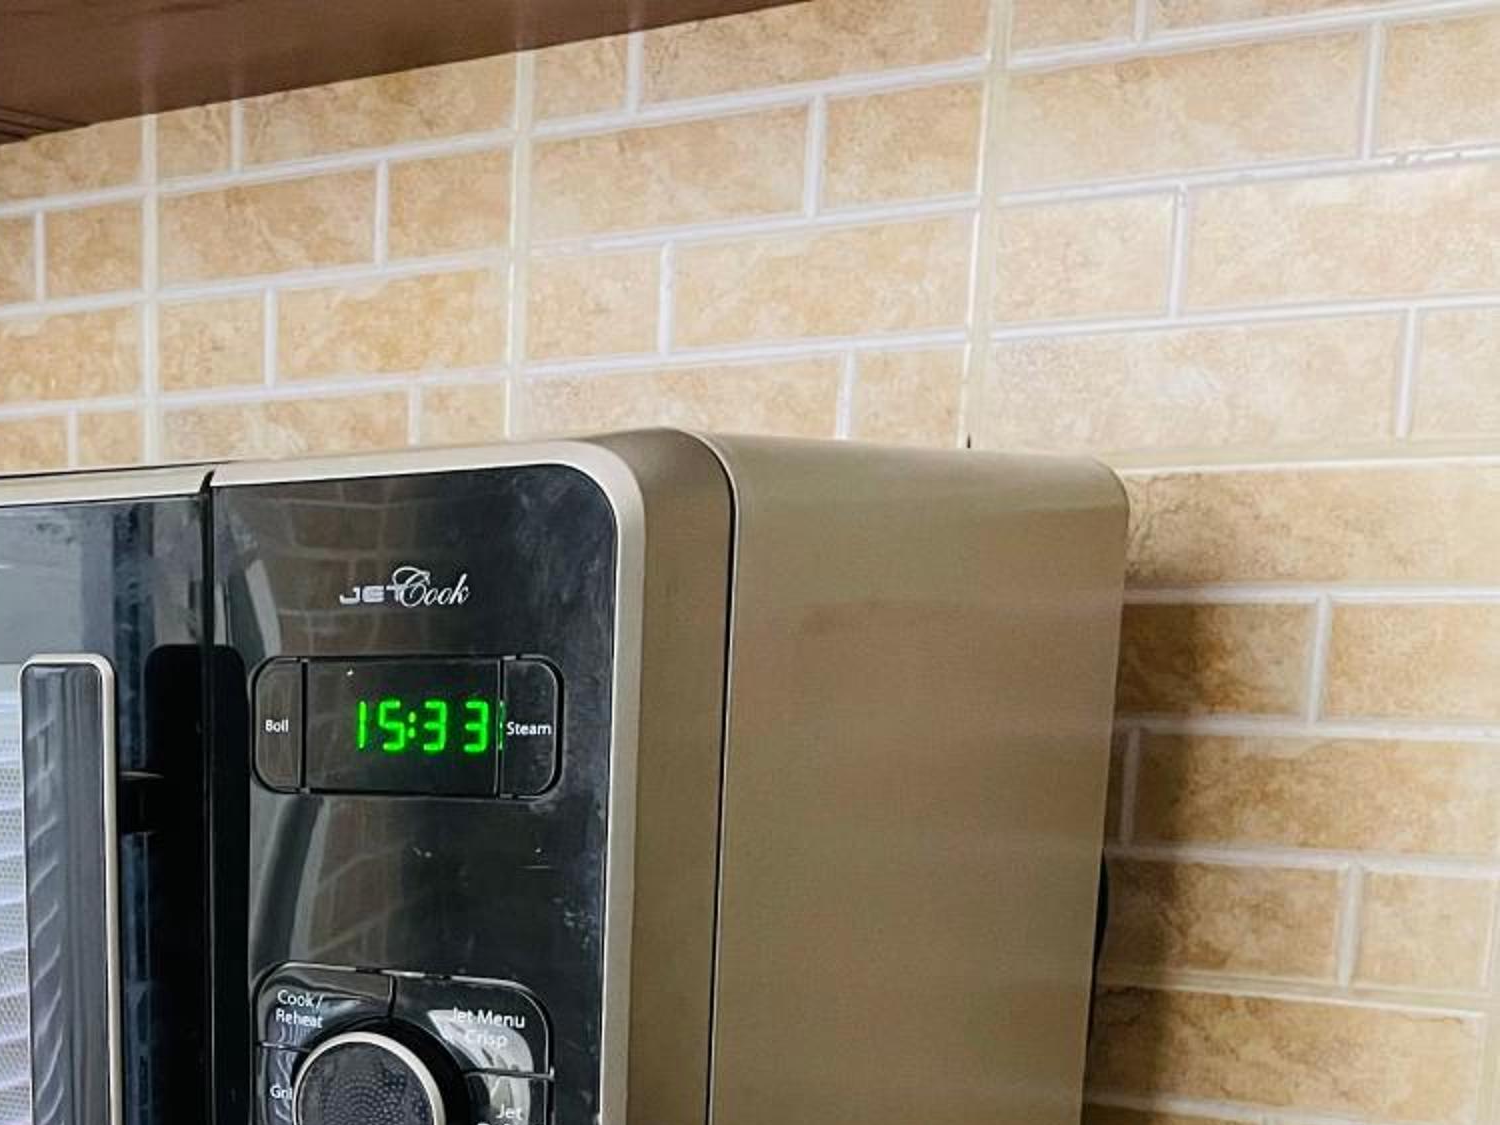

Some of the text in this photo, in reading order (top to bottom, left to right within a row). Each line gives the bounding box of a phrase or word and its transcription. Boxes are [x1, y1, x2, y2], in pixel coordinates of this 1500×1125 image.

[265, 718, 290, 733] Boil
[355, 699, 490, 753] 15:33
[506, 720, 552, 736] Steam
[274, 1007, 324, 1029] Reheat
[478, 1008, 526, 1029] Menu
[495, 1104, 522, 1121] Jet
